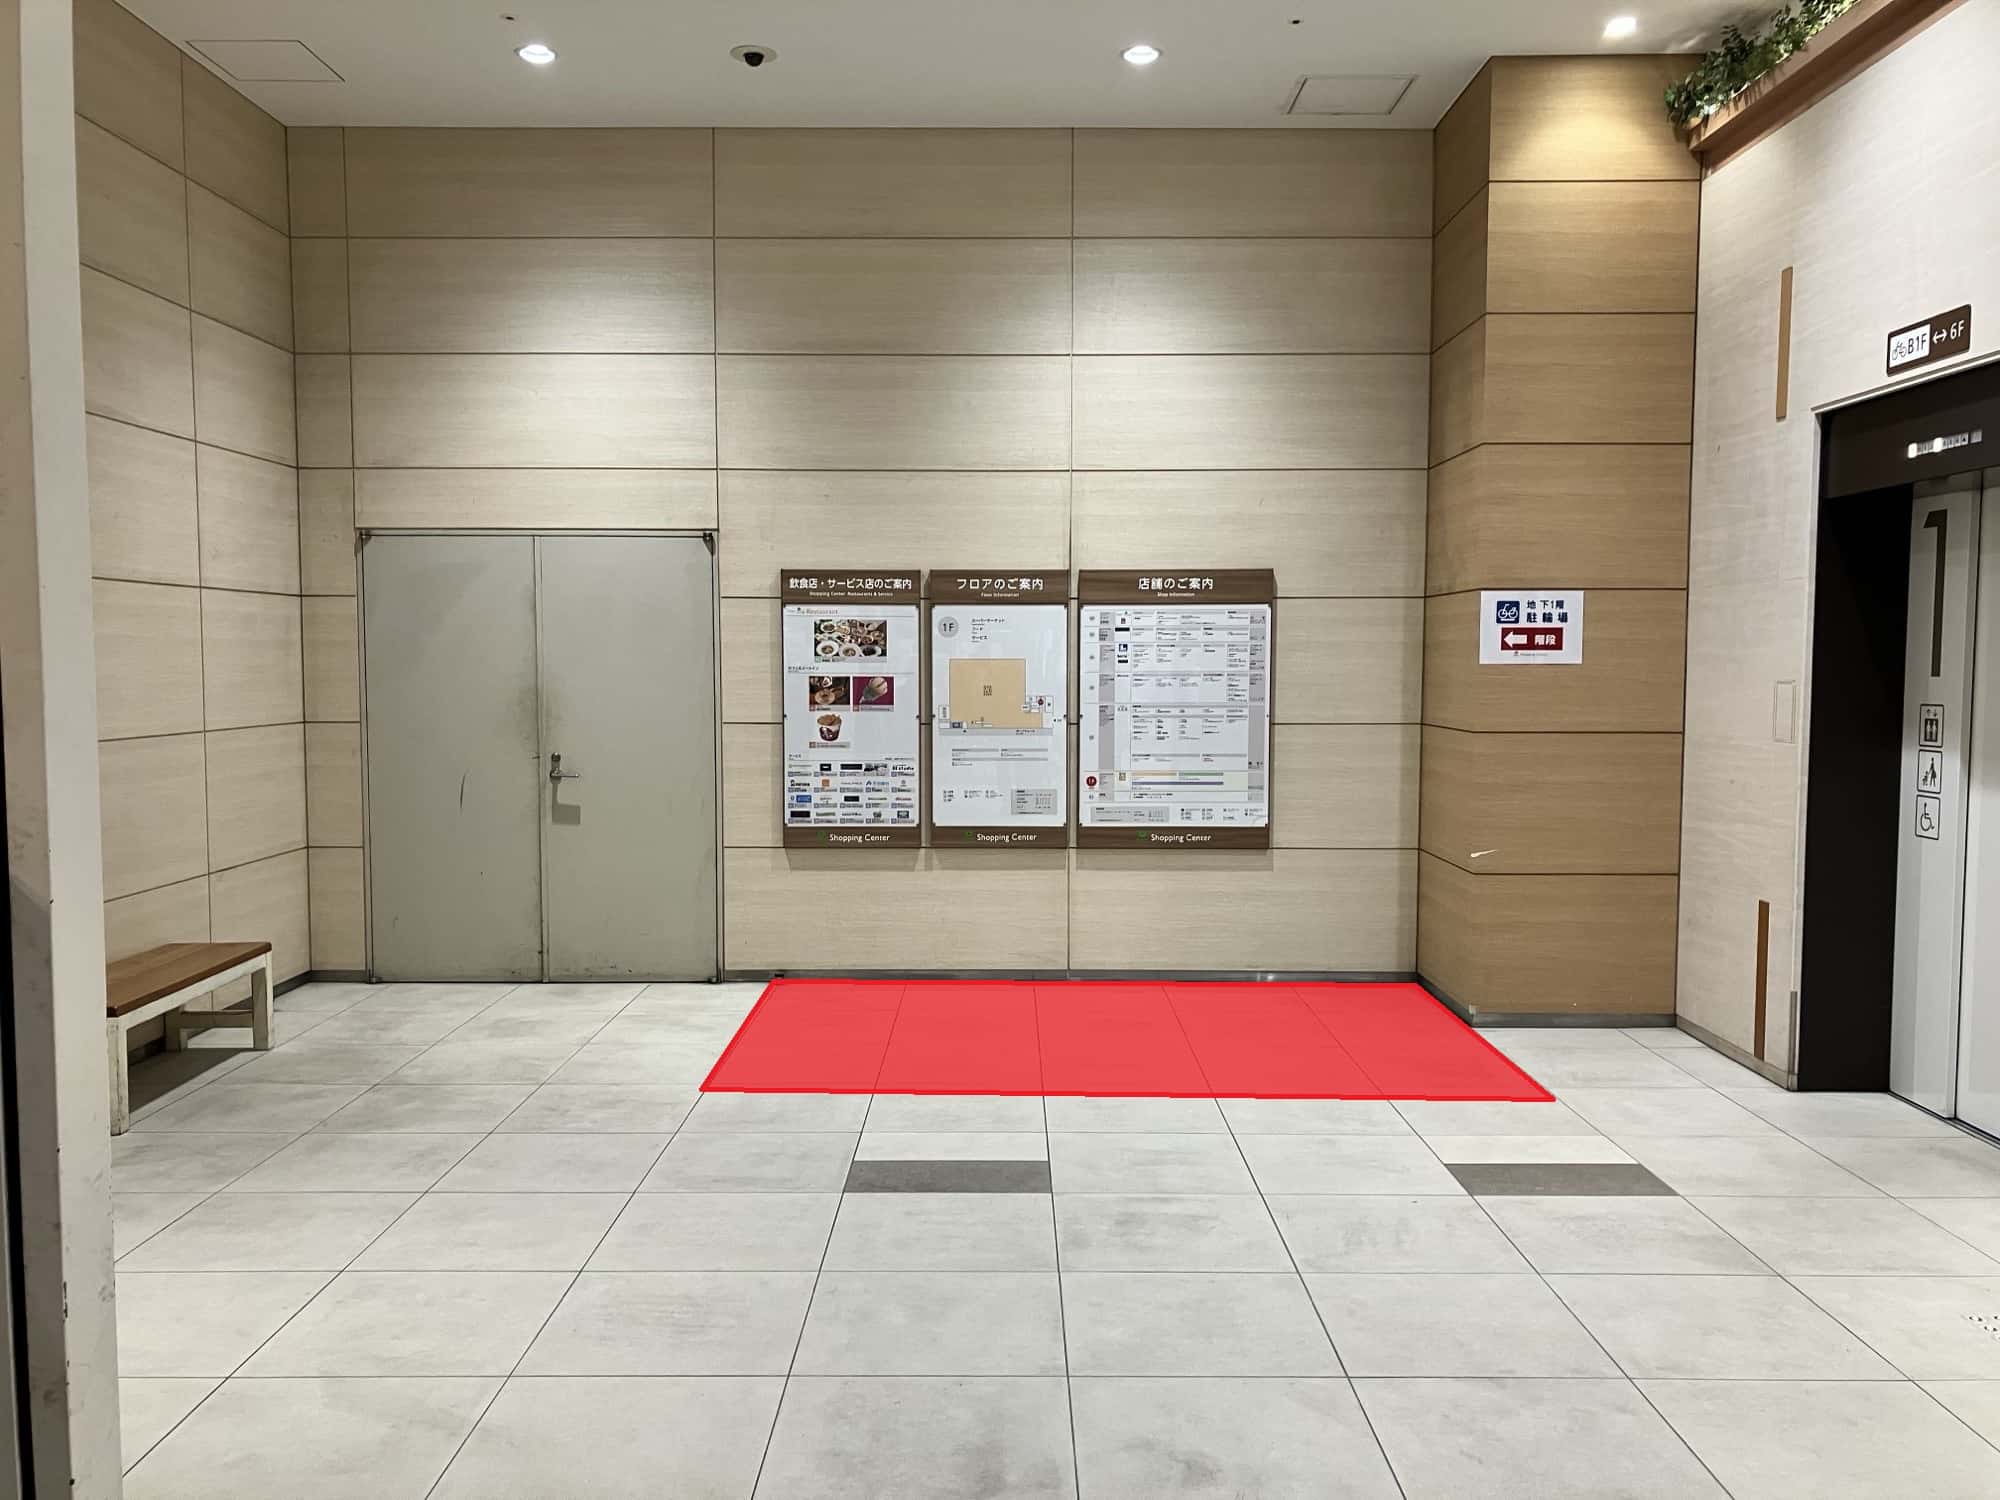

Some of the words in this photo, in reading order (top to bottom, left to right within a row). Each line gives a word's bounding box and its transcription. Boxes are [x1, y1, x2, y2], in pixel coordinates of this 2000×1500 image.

[1949, 320, 1965, 340] 6F
[1908, 333, 1927, 354] B1F
[789, 577, 912, 589] 飲食店・サービス店のご案内
[956, 578, 1043, 590] フロアのご案内
[1138, 577, 1214, 590] 店舗のご案内
[1923, 509, 1948, 677] 1
[1526, 600, 1564, 609] 地下1階
[1526, 612, 1568, 623] 駐輪場
[942, 623, 955, 632] 1F
[1534, 634, 1556, 646] 階段
[829, 834, 862, 843] Shopping
[976, 833, 1010, 842] Shopping
[1011, 833, 1037, 841] Center
[1150, 834, 1184, 843] Shopping
